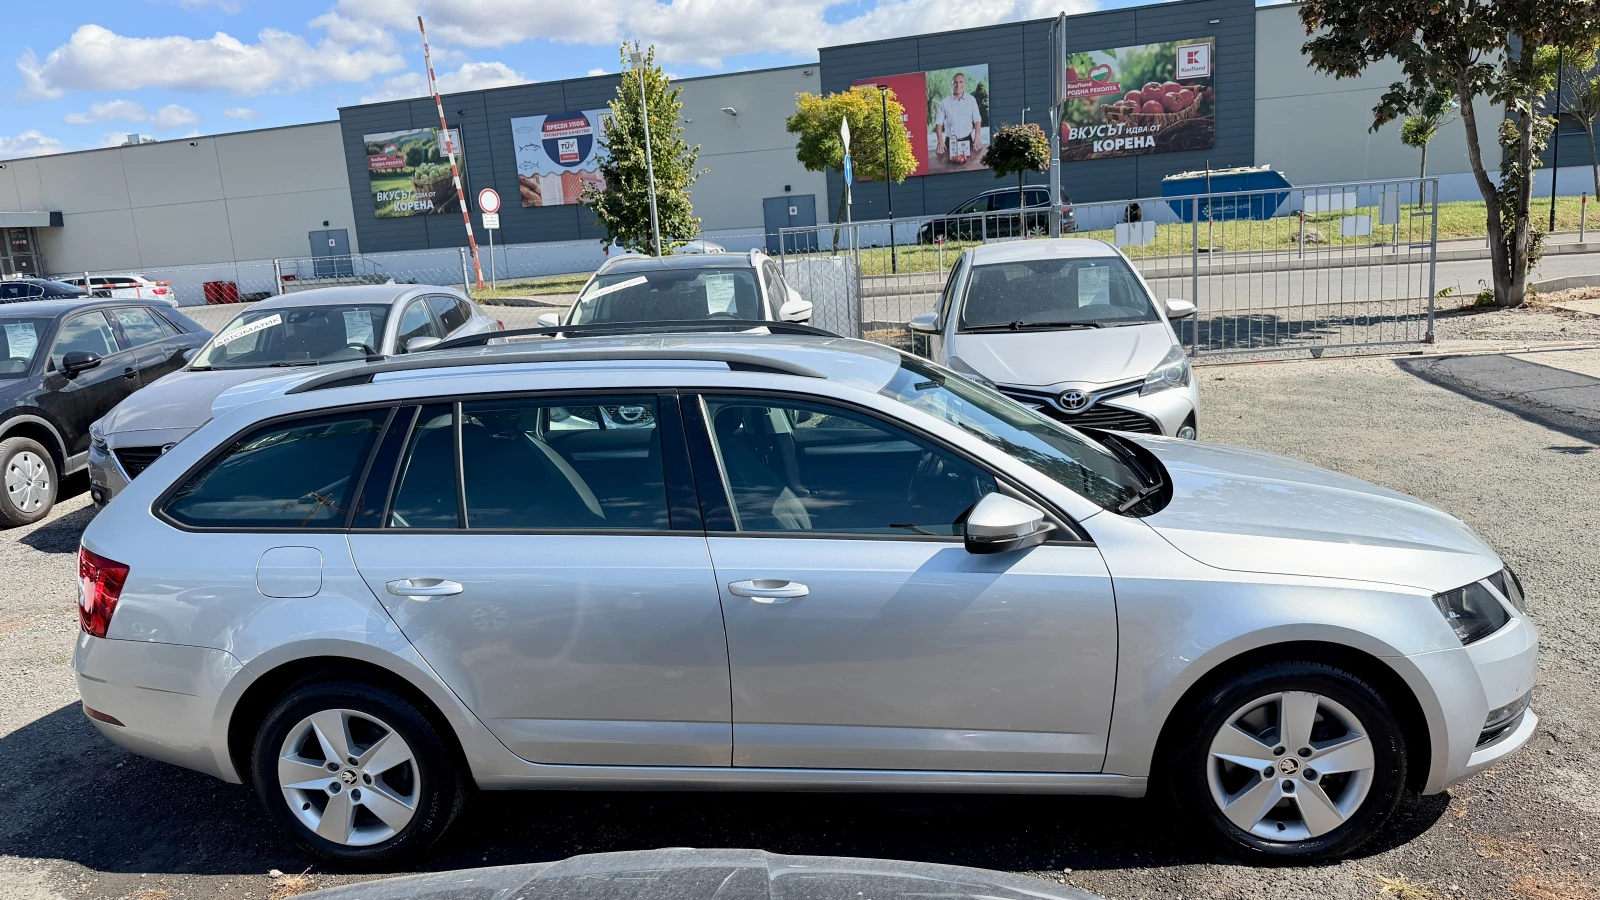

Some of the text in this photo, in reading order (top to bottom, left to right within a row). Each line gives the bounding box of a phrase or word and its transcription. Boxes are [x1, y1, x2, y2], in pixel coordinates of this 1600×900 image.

[1180, 65, 1206, 73] Kaufland
[1067, 85, 1117, 96] РОДНА РЕКОЛТА
[546, 120, 585, 131] ПРЕСЕН УЛОВ
[1068, 122, 1161, 140] ВКУСЪТ ИДВА ОТ
[1093, 136, 1156, 152] КОРЕНА
[376, 189, 412, 202] ВКУСЪТ
[394, 200, 434, 212] КОРЕНА
